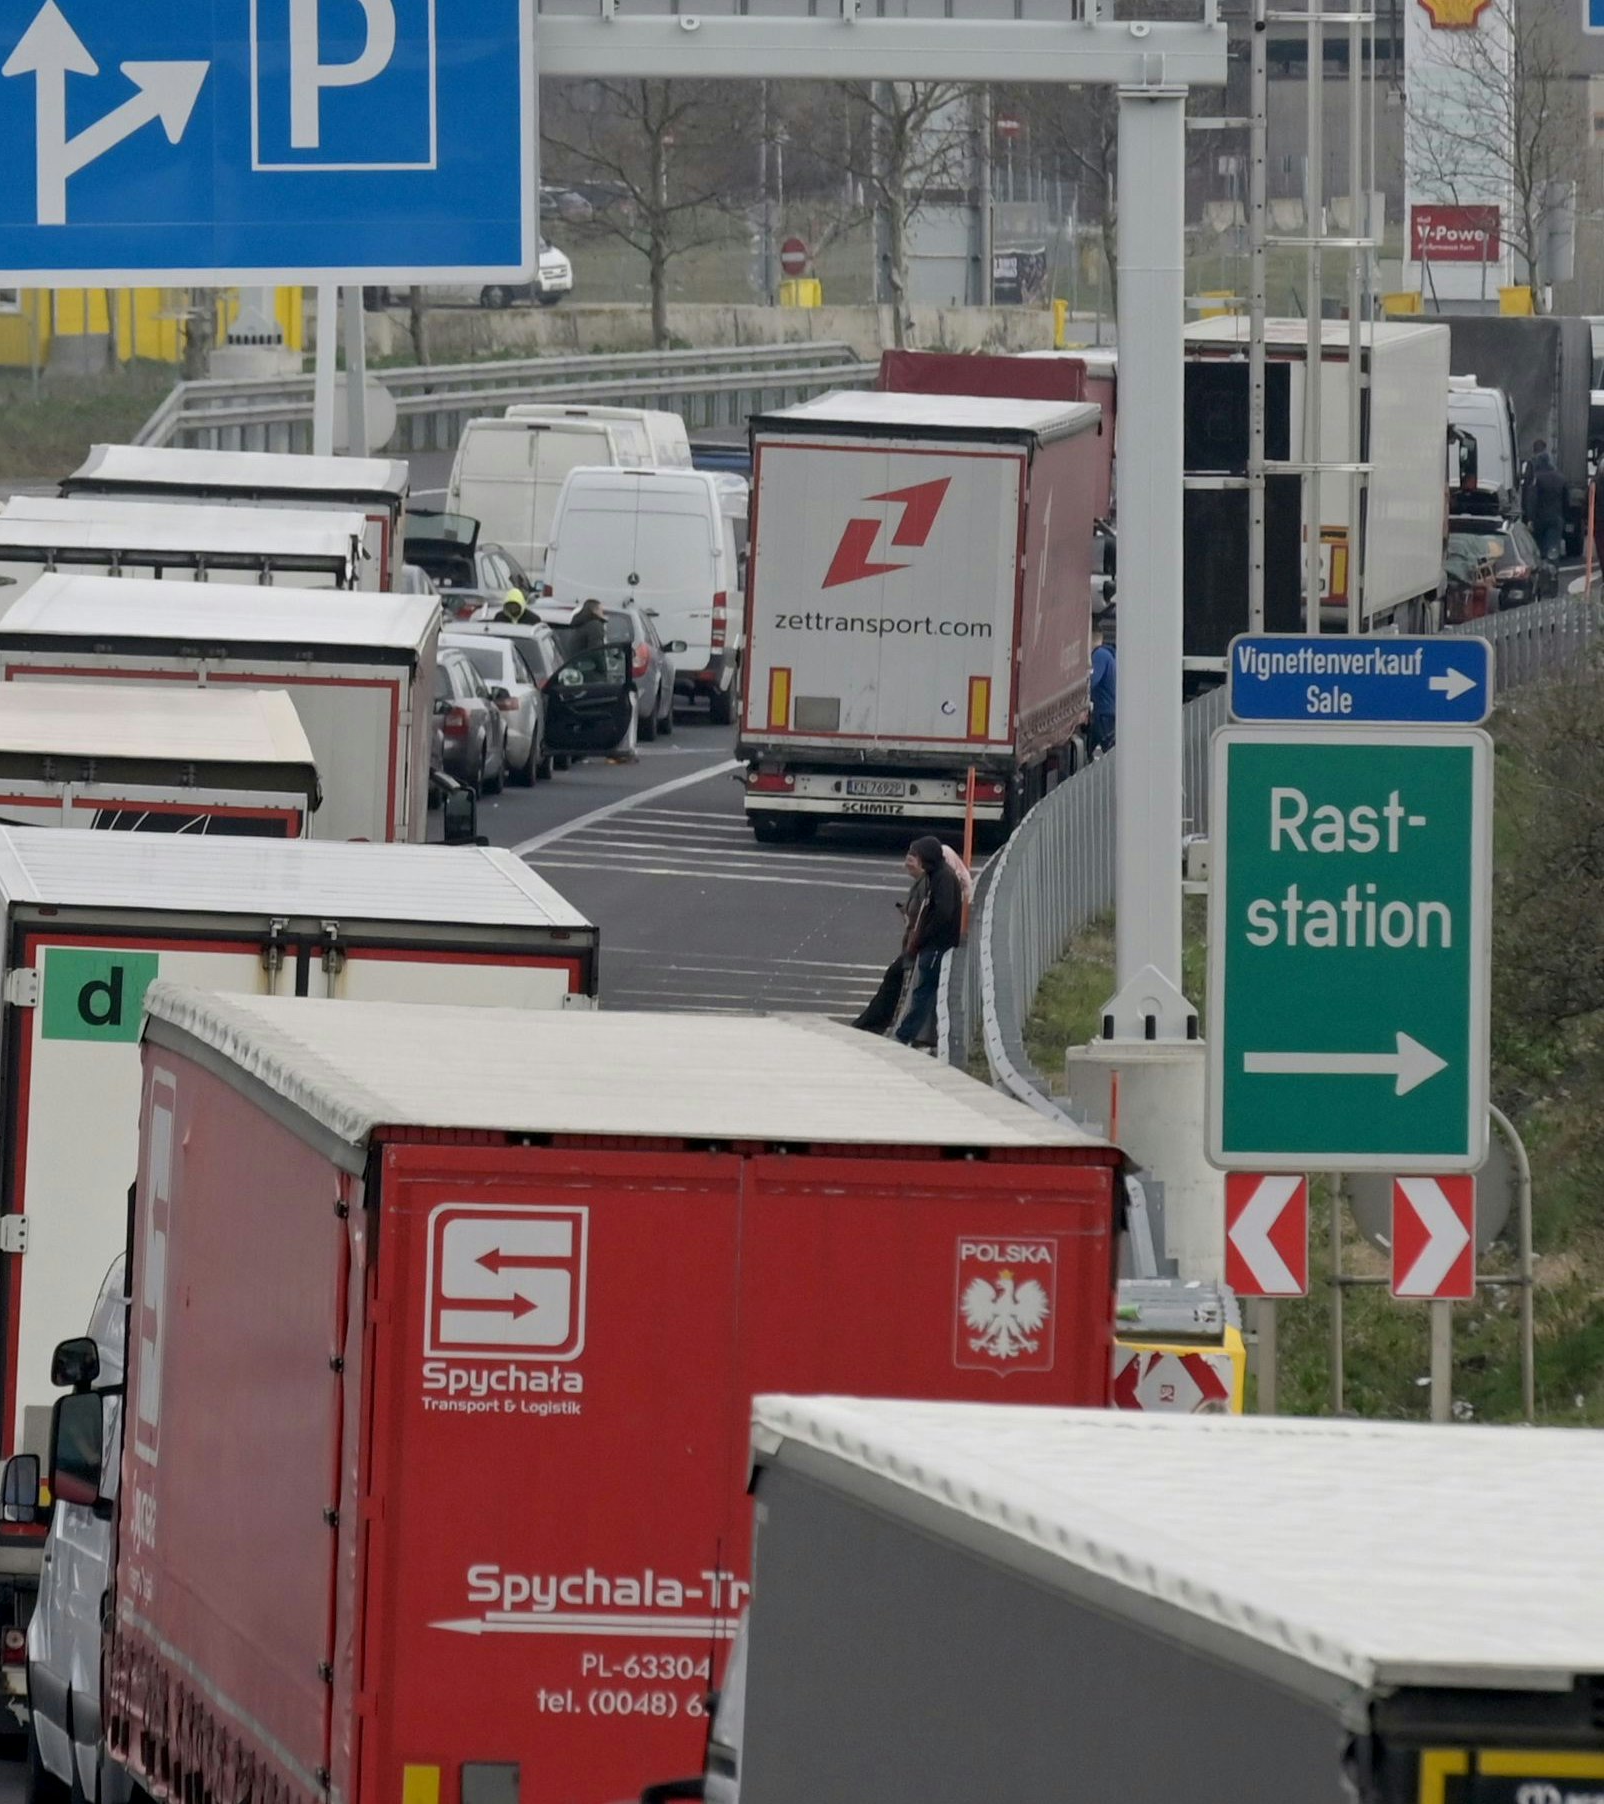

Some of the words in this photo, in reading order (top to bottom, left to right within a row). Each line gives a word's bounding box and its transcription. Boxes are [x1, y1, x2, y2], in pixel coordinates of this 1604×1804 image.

[290, 0, 396, 148] P
[775, 612, 992, 638] zettransport.com
[1238, 646, 1423, 680] Vignettenverkauf
[1307, 685, 1353, 714] Sale
[842, 803, 904, 815] SCHMITZ
[1270, 787, 1426, 853] Rast-
[1246, 883, 1452, 948] station
[78, 966, 124, 1026] d
[961, 1243, 1053, 1263] POLSKA
[422, 1362, 584, 1397] Spychała
[422, 1396, 500, 1413] Transport
[521, 1400, 581, 1416] Logistik
[581, 1653, 710, 1680] PL-63304
[537, 1689, 581, 1714] tel.
[589, 1690, 677, 1718] (0048)
[687, 1694, 710, 1717] 6
